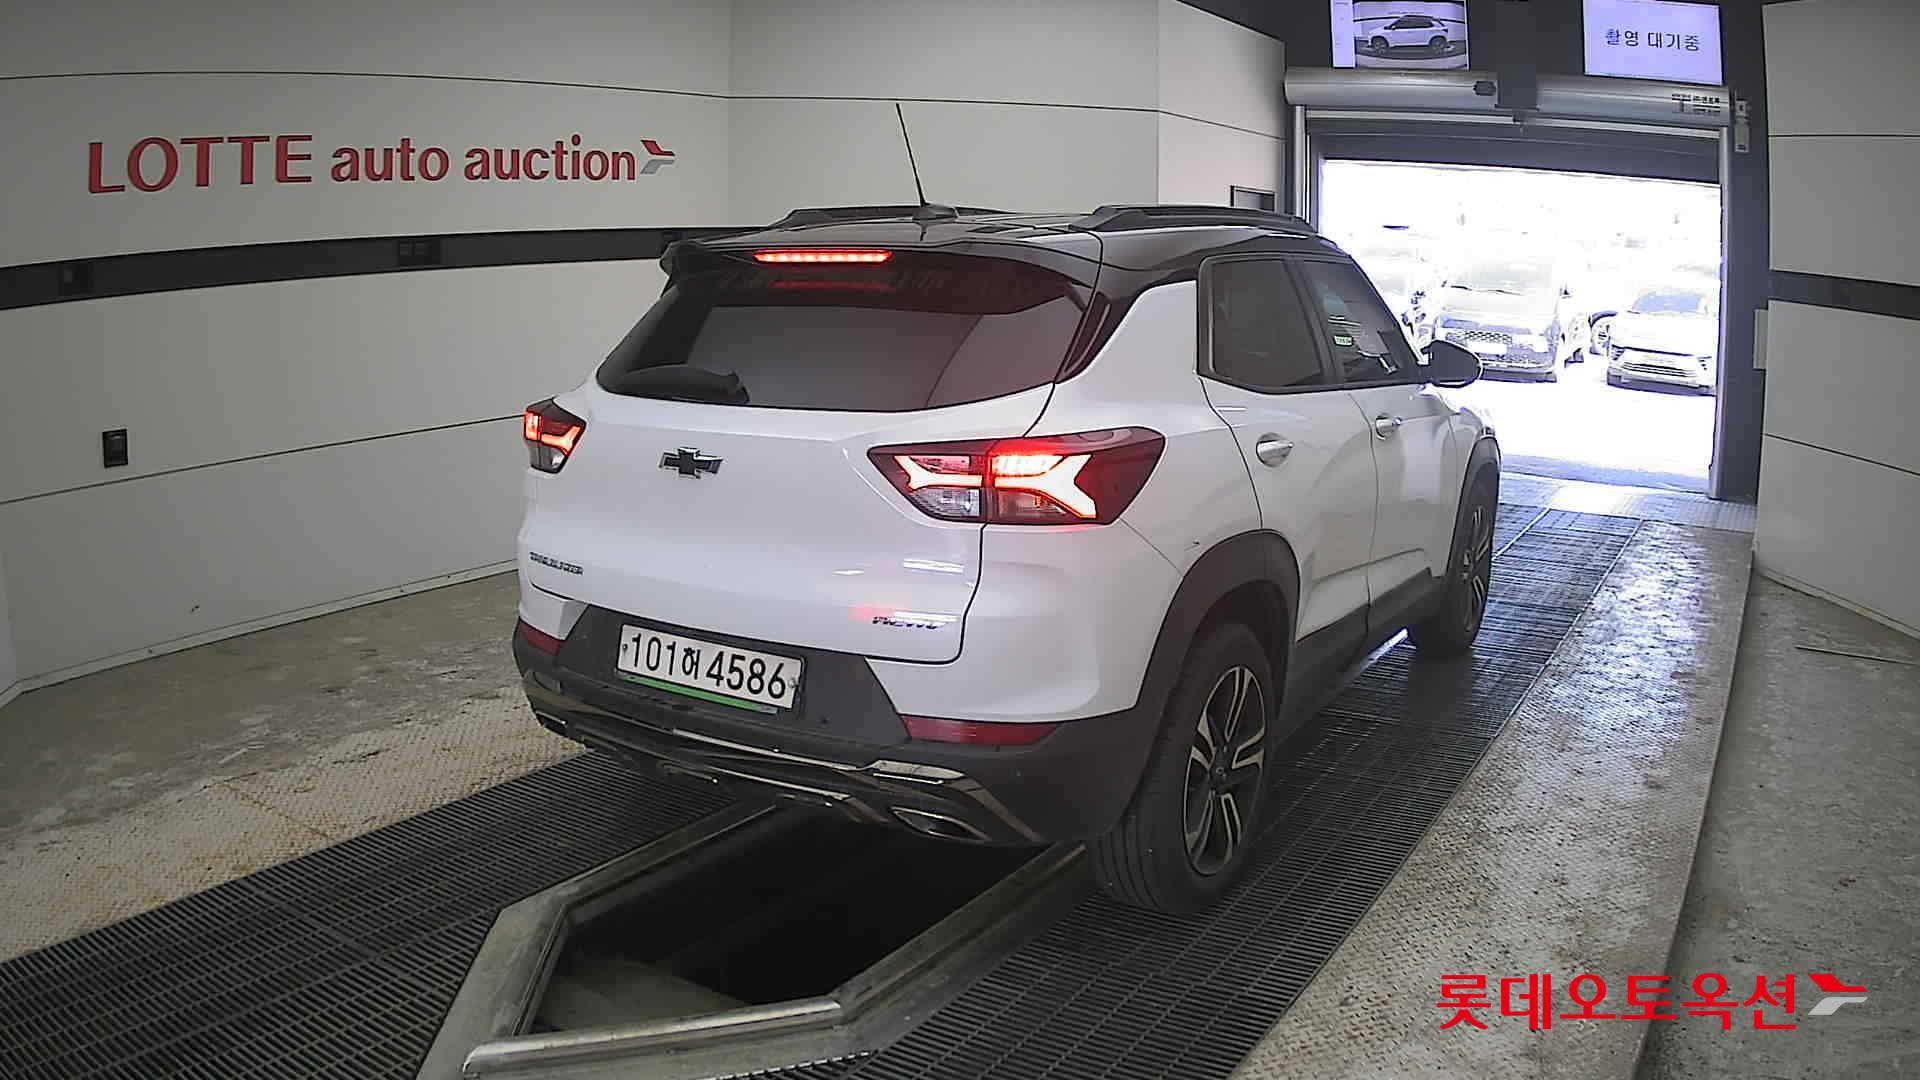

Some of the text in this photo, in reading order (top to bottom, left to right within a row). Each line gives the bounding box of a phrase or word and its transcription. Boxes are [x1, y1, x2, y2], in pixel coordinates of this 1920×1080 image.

[1647, 32, 1700, 52] 대기중
[88, 134, 637, 193] LOTTE auto auction
